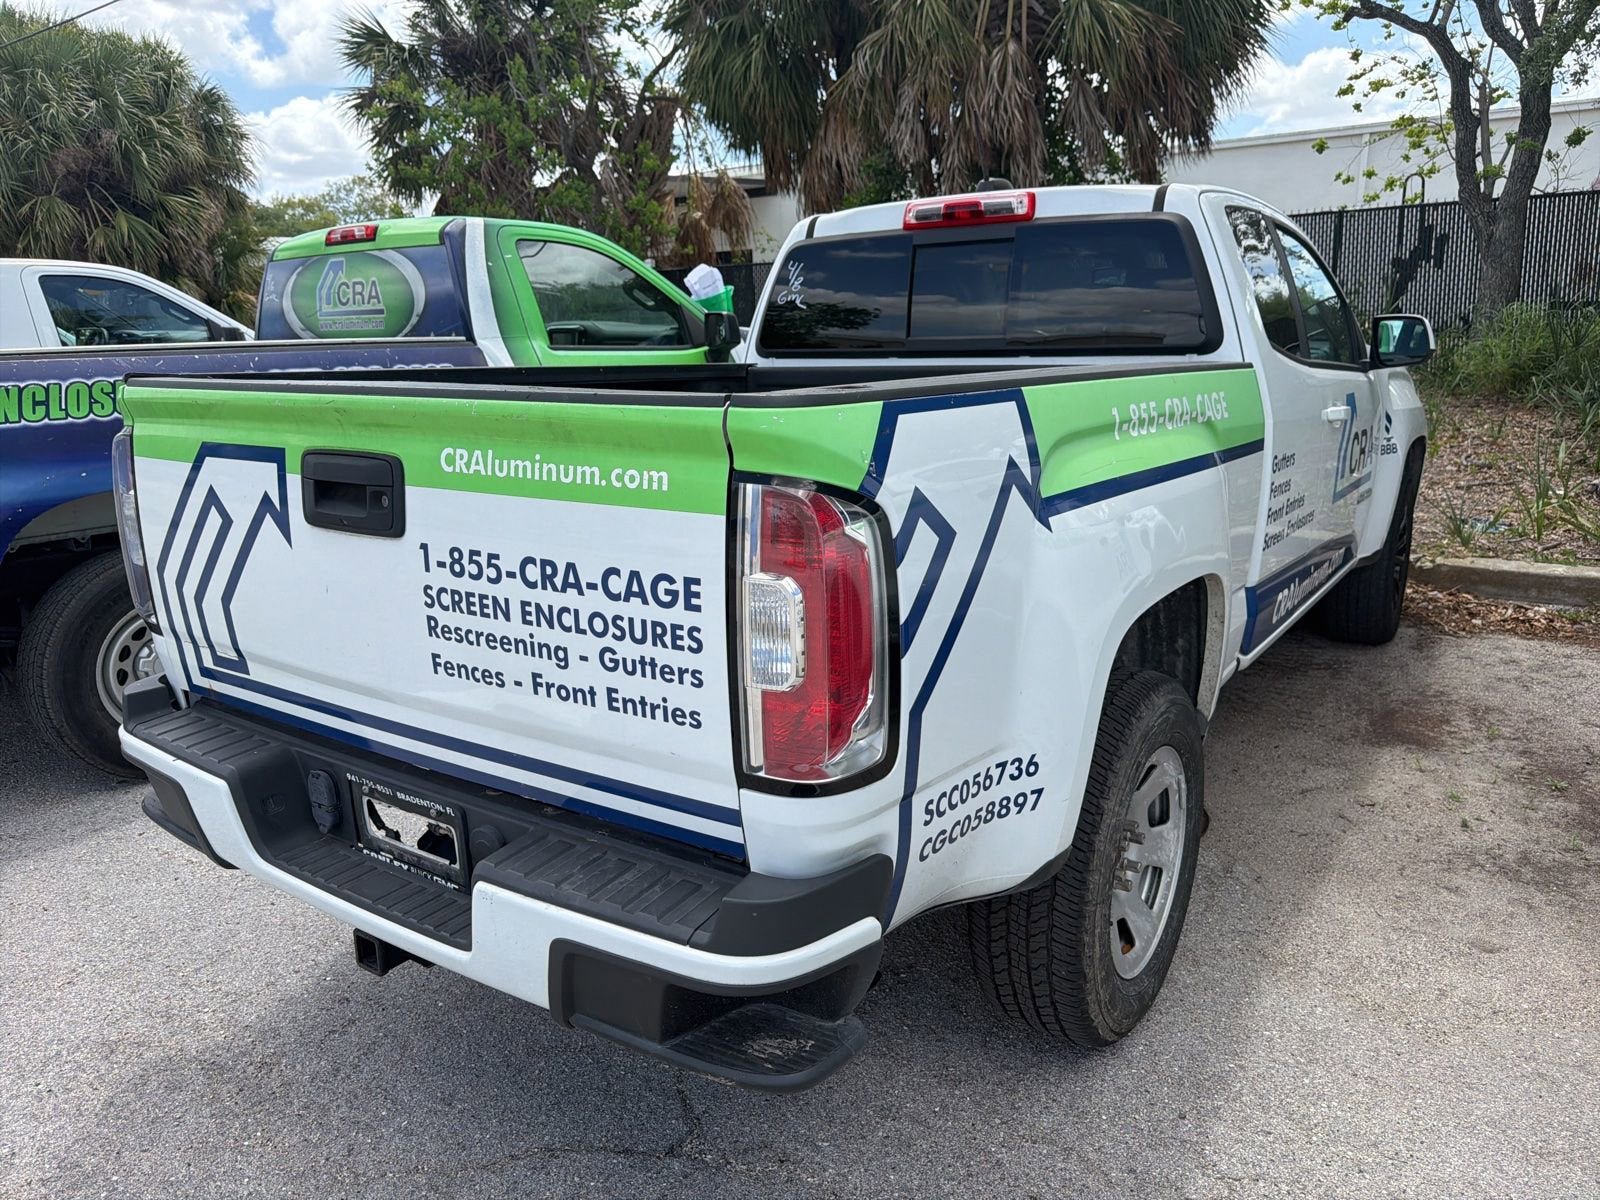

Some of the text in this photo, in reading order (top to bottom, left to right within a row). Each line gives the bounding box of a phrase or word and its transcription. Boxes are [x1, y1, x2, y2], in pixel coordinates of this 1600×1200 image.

[336, 278, 382, 307] CRA
[1112, 391, 1229, 441] 1-855-CRA-CAGE
[440, 447, 668, 491] CRAluminum.com
[1272, 453, 1295, 474] Gutters
[1380, 442, 1399, 456] BBB
[1266, 492, 1305, 526] Front Entries
[1269, 479, 1291, 501] Fences
[1262, 509, 1315, 552] Screen Enclosures
[418, 542, 702, 613] 1-855-CRA-CAGE
[423, 584, 704, 655] SCREEN ENCLOSURES
[426, 615, 569, 670] Rescreening
[598, 646, 704, 689] Gutters
[431, 652, 506, 689] Fences
[531, 672, 597, 708] Front
[606, 687, 702, 730] Entries
[445, 805, 455, 817] FL
[923, 753, 1040, 827] SCC056736
[919, 787, 1045, 863] CGC058897
